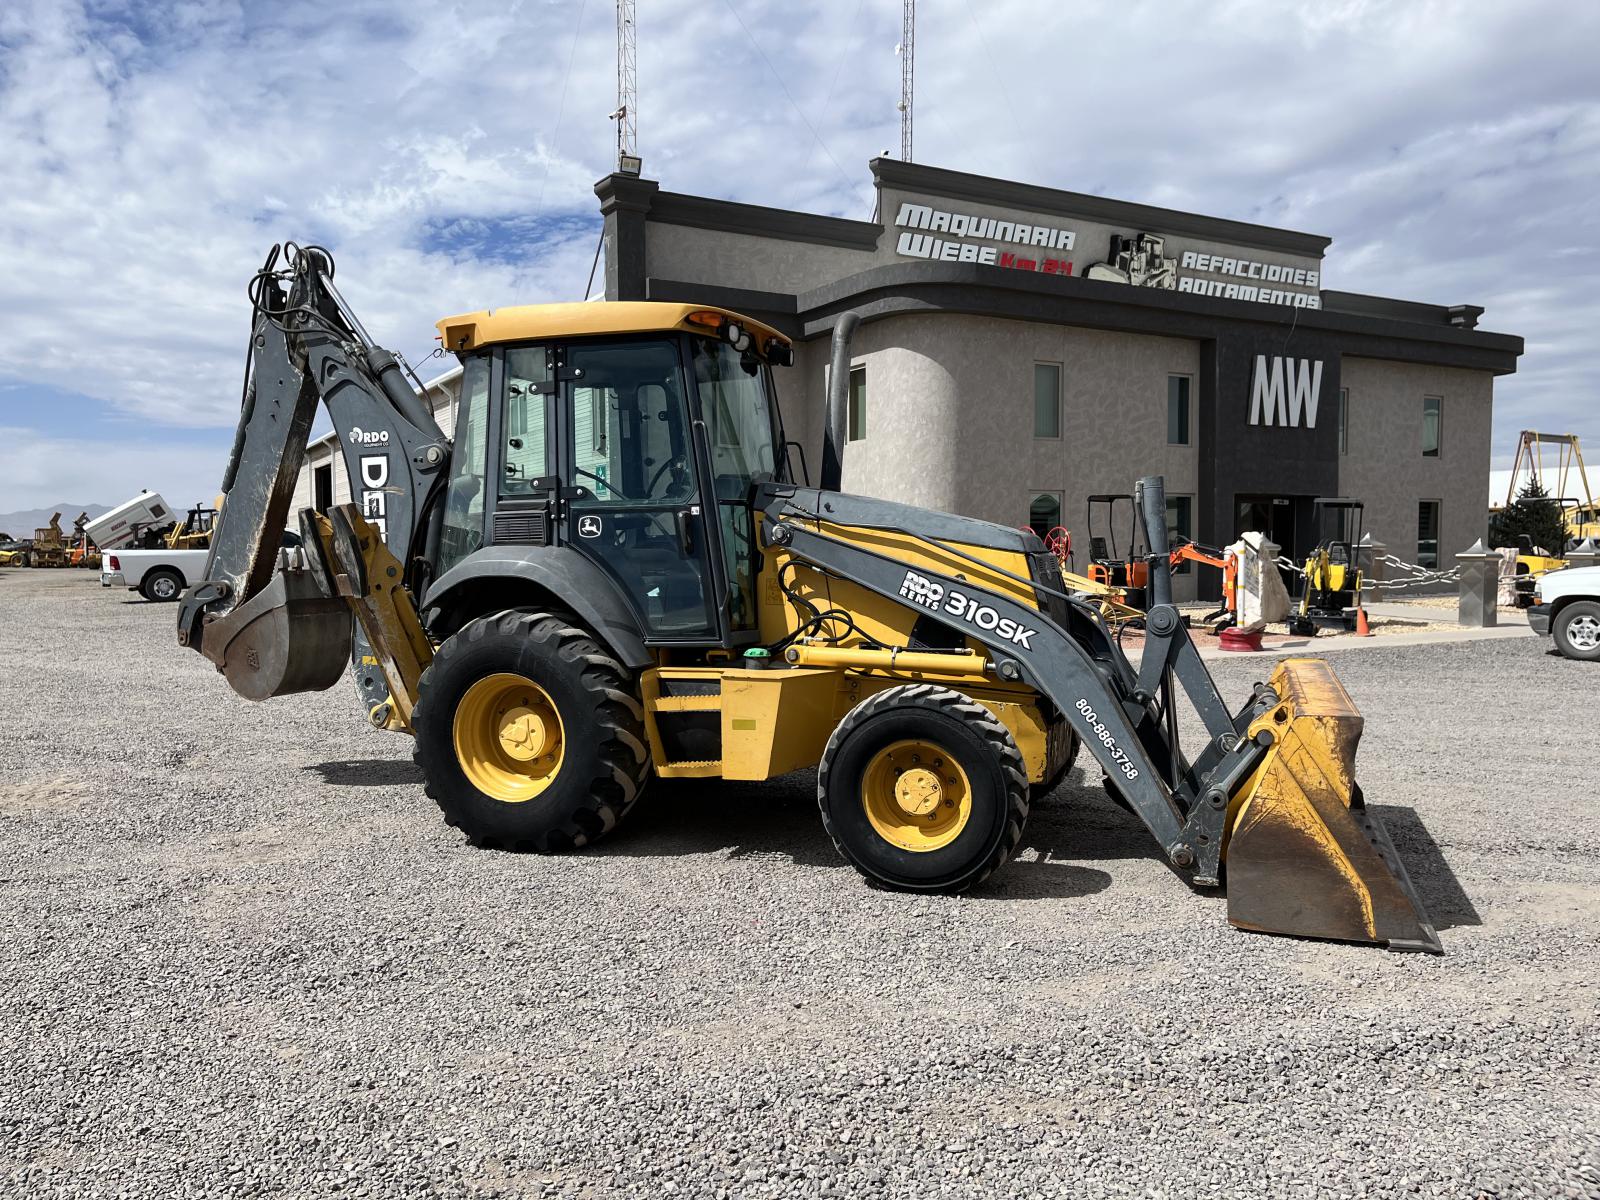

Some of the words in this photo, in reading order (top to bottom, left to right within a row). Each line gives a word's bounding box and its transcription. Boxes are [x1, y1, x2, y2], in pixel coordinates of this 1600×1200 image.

[895, 203, 1076, 250] MAQUINARIA
[896, 232, 997, 265] WIEBE
[1181, 251, 1320, 287] REFACCIONES
[1178, 277, 1322, 310] ADITAMENTOS
[1249, 354, 1323, 429] MW
[899, 586, 940, 611] RENTS
[902, 570, 944, 601] RDO
[944, 591, 1037, 650] 310SK
[1075, 698, 1139, 780] 800-886-3758
